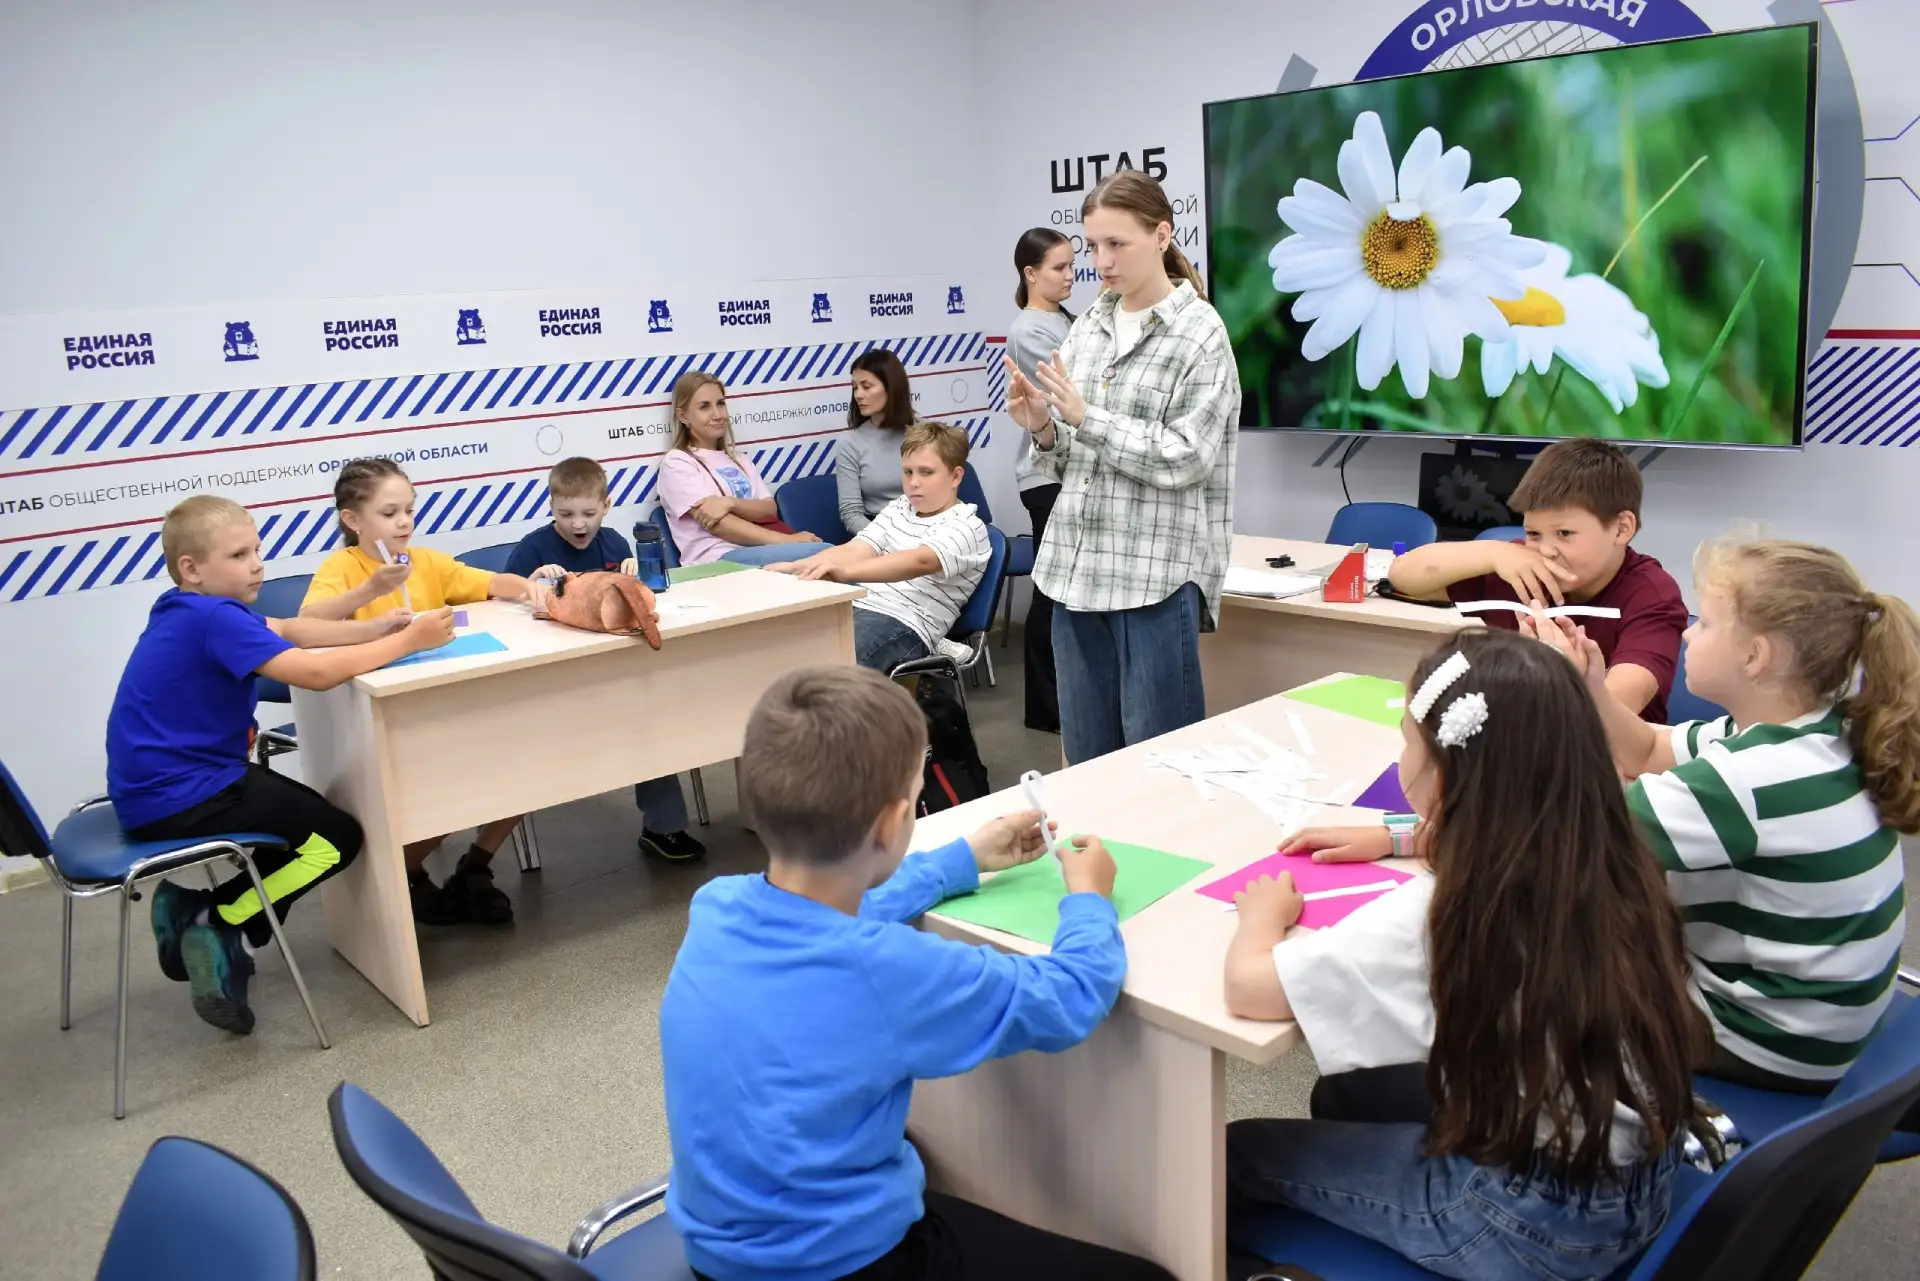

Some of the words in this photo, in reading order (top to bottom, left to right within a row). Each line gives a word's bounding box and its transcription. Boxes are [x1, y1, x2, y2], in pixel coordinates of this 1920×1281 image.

[1411, 0, 1647, 51] ОРЛОАЯ
[1051, 147, 1168, 193] ШТАБ
[719, 300, 770, 313] ЕДИНАЯ
[870, 293, 913, 305] ЕДИНАЯ
[539, 308, 600, 322] ЕДИНАЯ
[720, 313, 771, 326] РОССИЯ
[871, 305, 914, 317] РОССИЯ
[323, 318, 397, 335] ЕДИНАЯ
[541, 322, 602, 337] РОССИЯ
[63, 333, 153, 353] ЕДИНАЯ
[325, 333, 399, 352] РОССИЯ
[66, 350, 156, 371] РОССИЯ
[608, 426, 644, 439] ШТАБ
[745, 407, 812, 424] ПОДДЕРЖКИ
[814, 402, 849, 415] ОРЛОВ
[49, 474, 203, 508] ОБЩЕСТВЕННОЙ
[208, 463, 314, 487] ПОДДЕРЖКИ
[419, 442, 488, 461] ОБЛАСТИ
